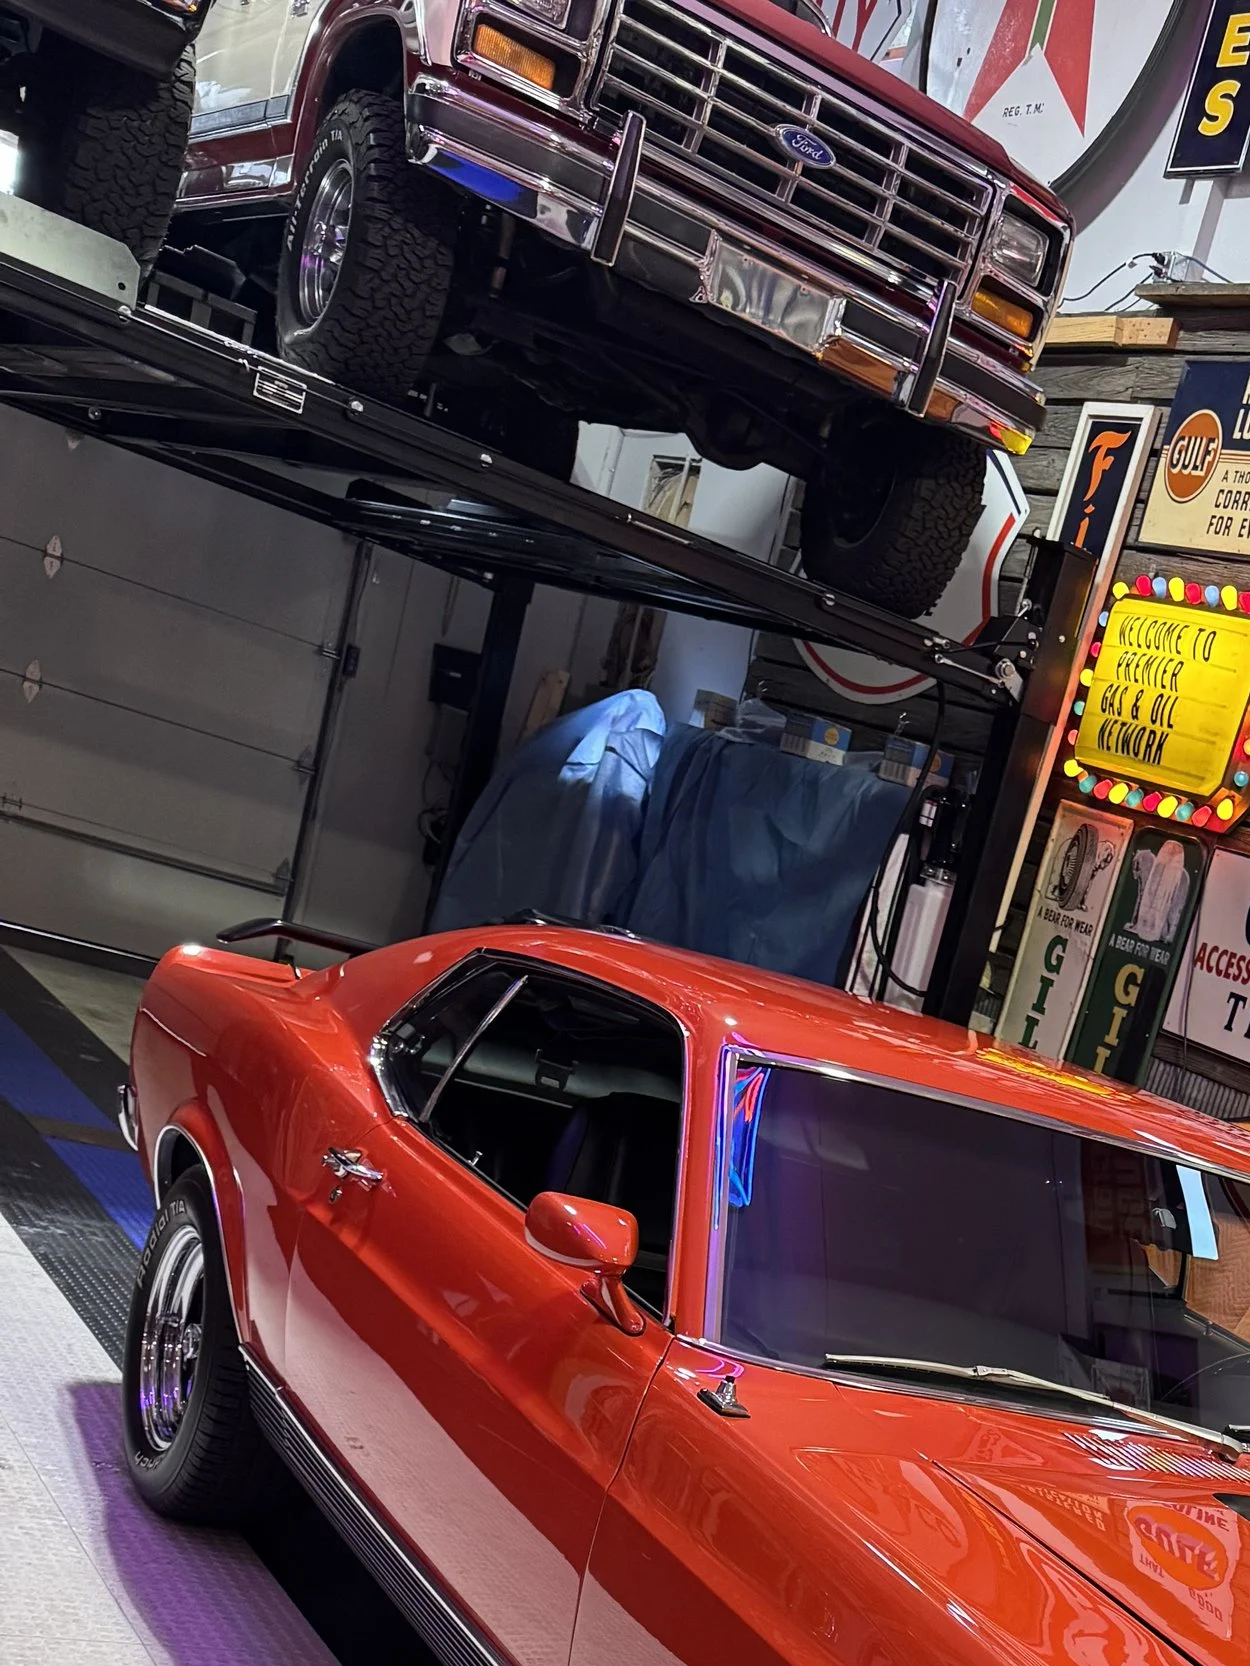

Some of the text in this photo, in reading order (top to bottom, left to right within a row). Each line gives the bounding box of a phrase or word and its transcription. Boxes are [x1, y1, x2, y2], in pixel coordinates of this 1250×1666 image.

[792, 134, 823, 160] Ford
[1170, 436, 1219, 477] GULF
[1221, 470, 1229, 483] A
[1206, 515, 1234, 536] FOR
[1119, 614, 1217, 663] WELCOME TO
[1116, 650, 1184, 693] PREMIER
[1101, 683, 1179, 729] GAS & OIL
[1097, 718, 1169, 766] NETWORK
[1036, 908, 1094, 937] A BEAR FOR WEAR
[1116, 935, 1135, 953] BEAR
